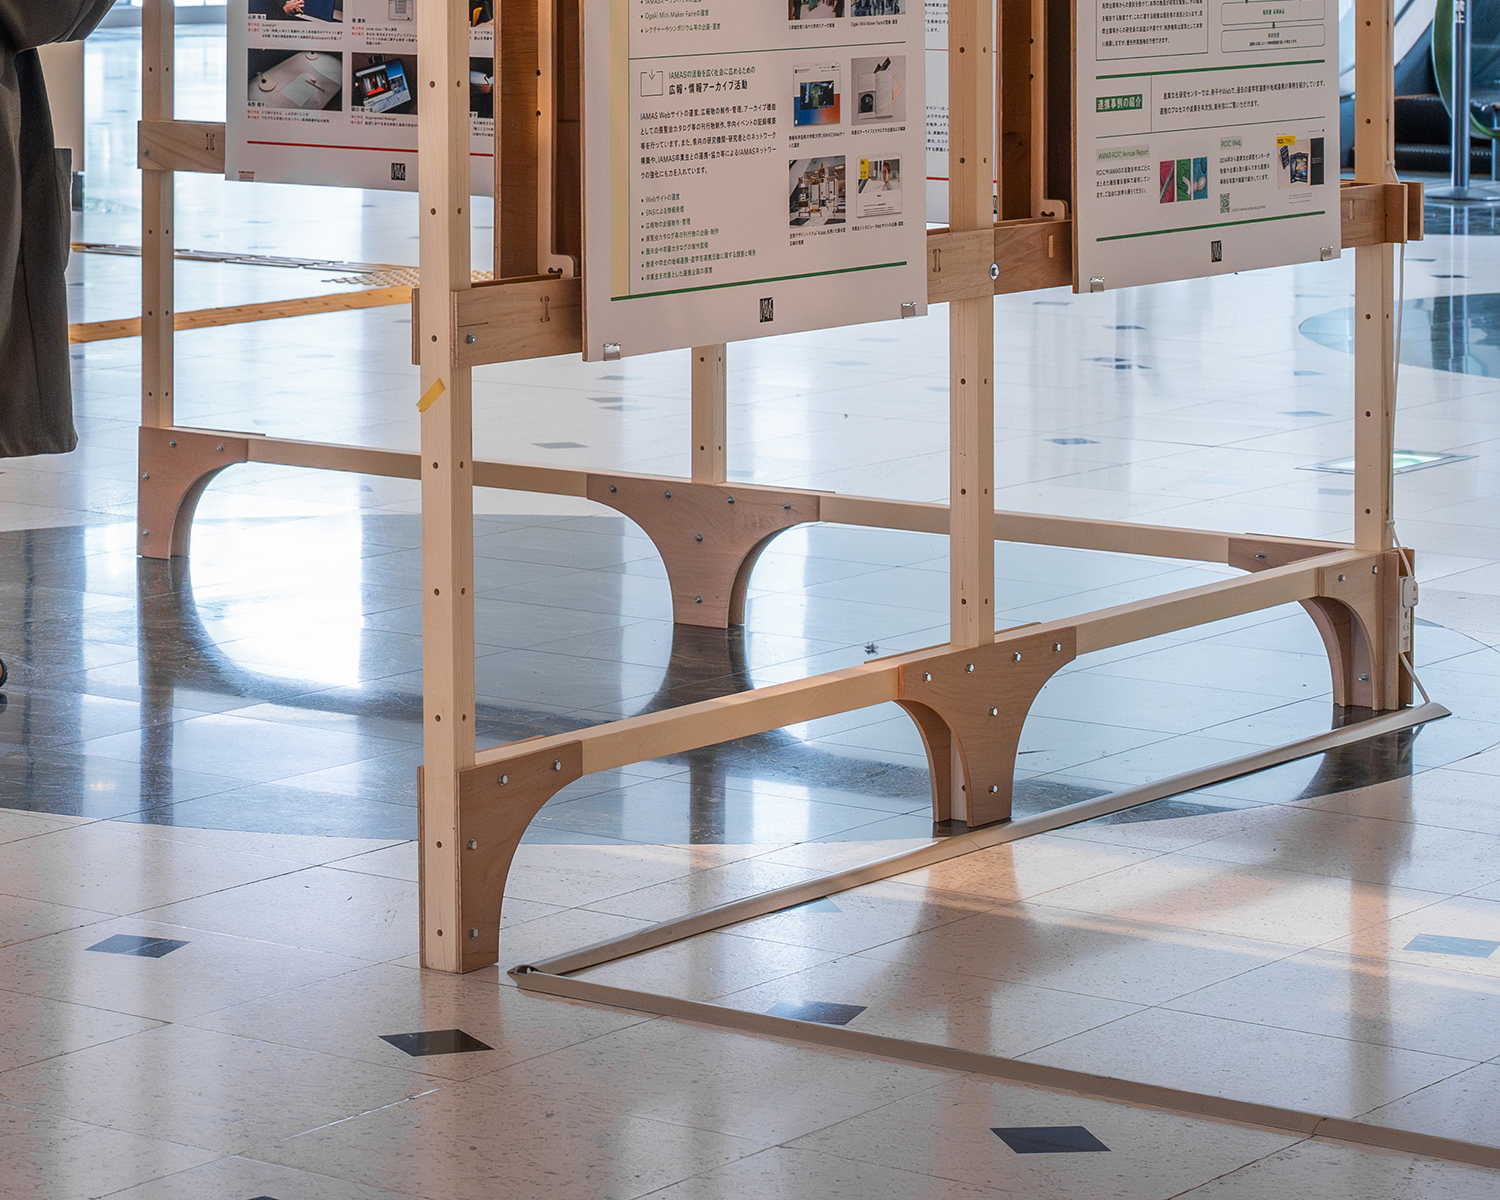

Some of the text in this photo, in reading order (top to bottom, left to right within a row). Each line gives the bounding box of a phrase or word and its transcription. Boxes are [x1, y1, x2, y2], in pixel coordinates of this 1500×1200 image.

[668, 80, 748, 95] 広報・情報アーカイブ活動
